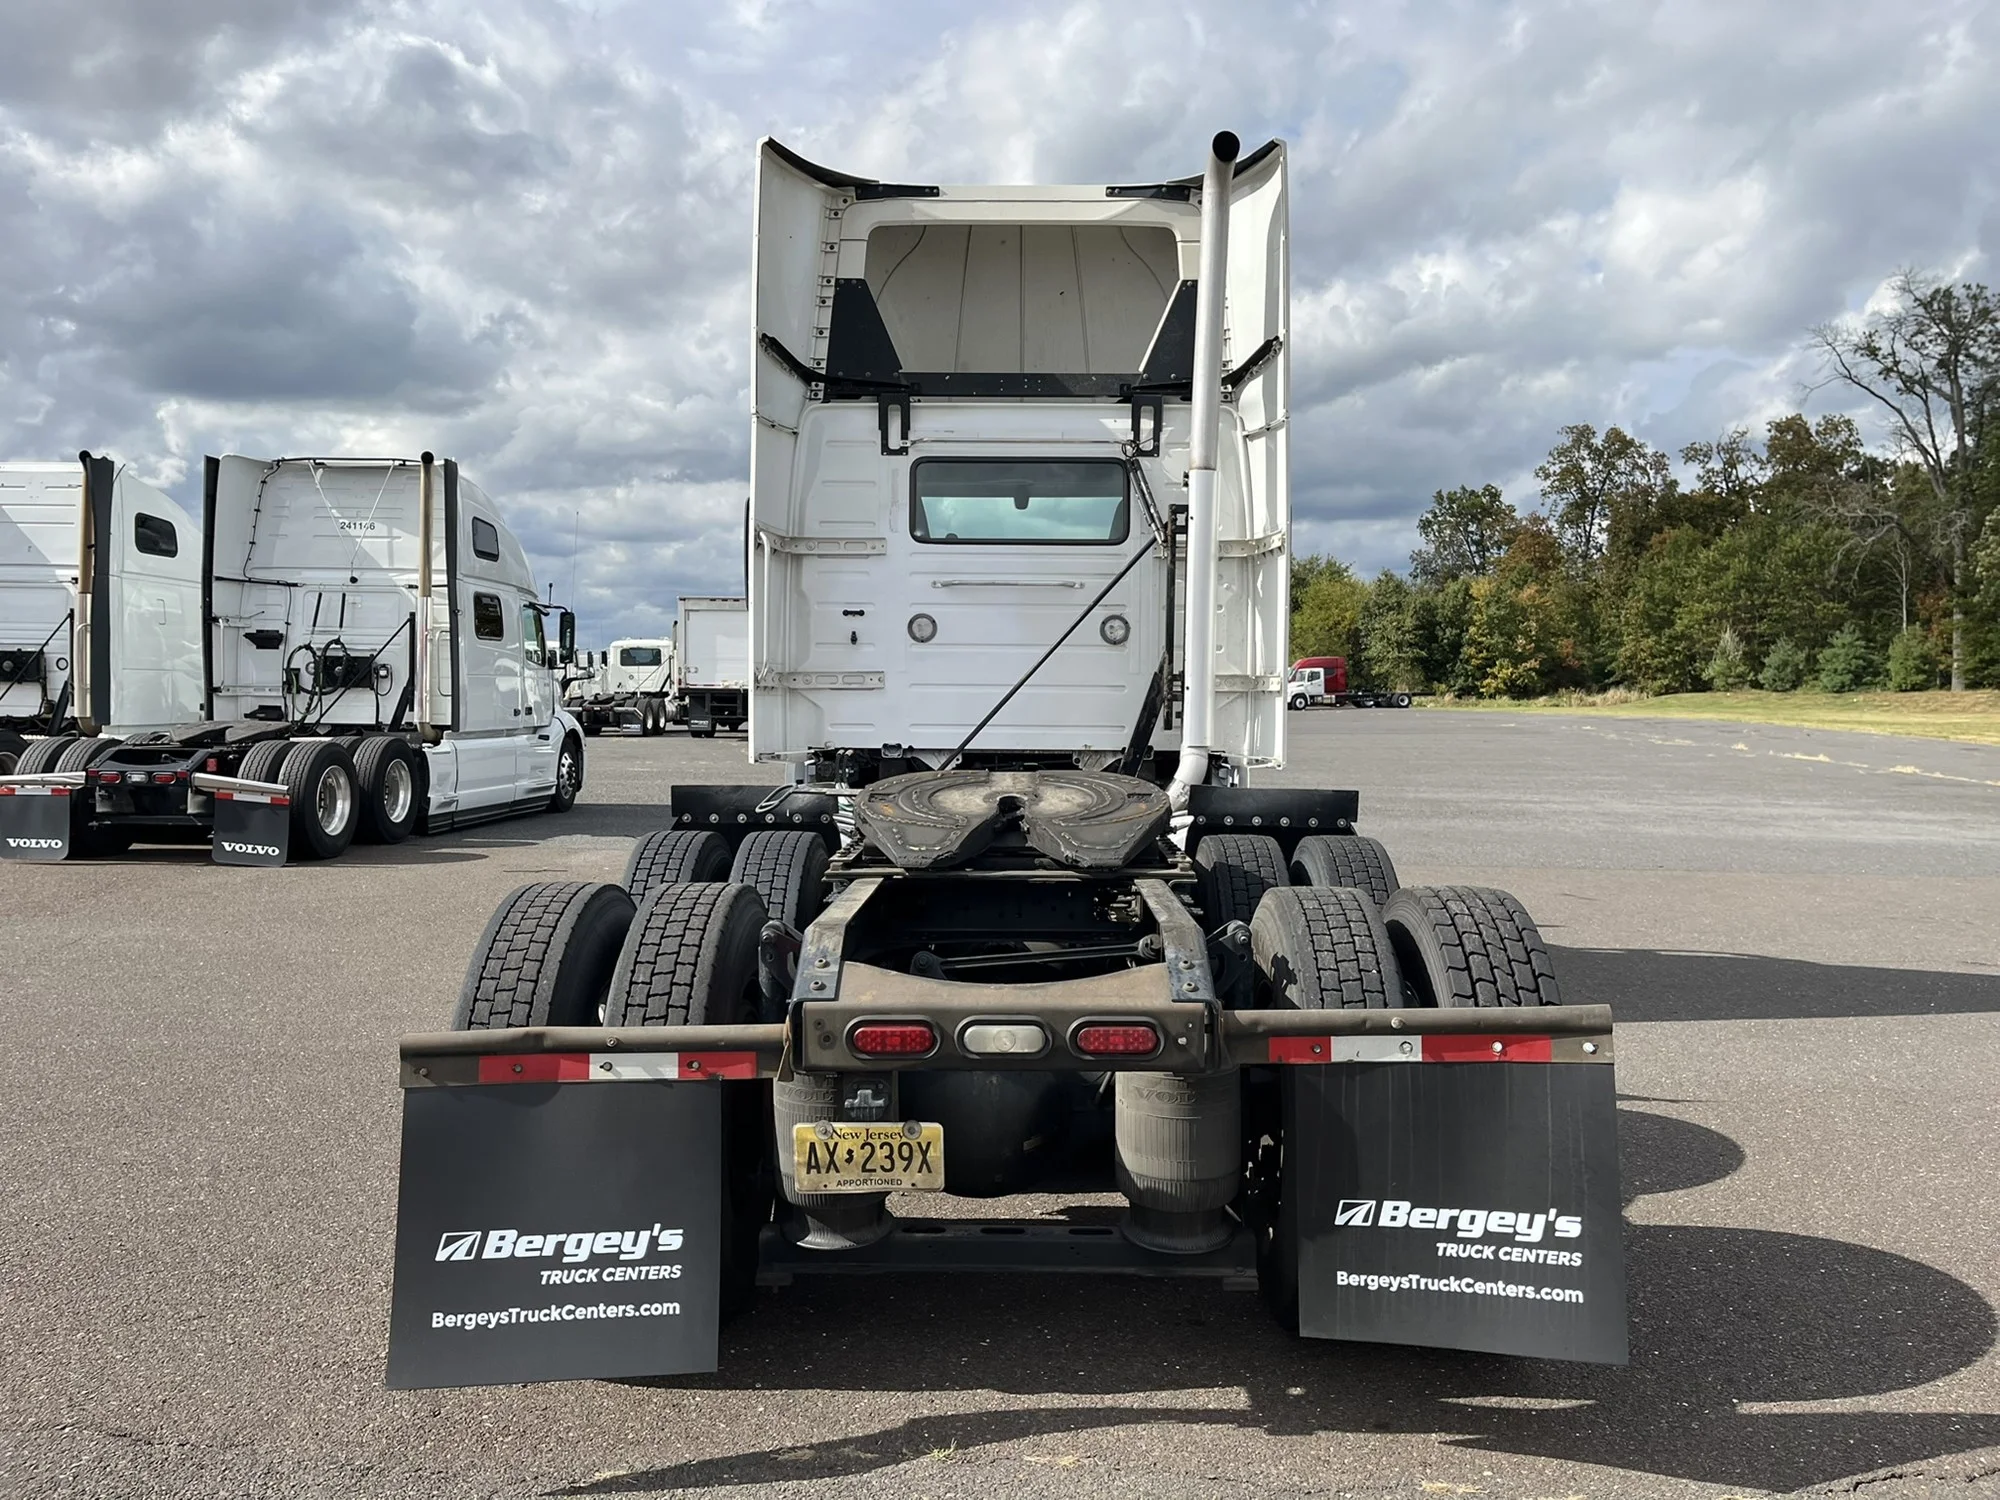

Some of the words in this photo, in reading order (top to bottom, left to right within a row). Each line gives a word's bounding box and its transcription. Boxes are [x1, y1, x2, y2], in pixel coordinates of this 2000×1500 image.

[6, 837, 63, 850] VOLVO
[221, 841, 280, 857] VOLVO
[831, 1128, 862, 1141] New
[863, 1128, 905, 1142] Jersey
[806, 1141, 841, 1175] AX
[860, 1141, 933, 1174] 239X
[836, 1177, 903, 1187] APPORTIONED
[1377, 1199, 1583, 1243] Bergey's
[481, 1222, 684, 1264] Bergey's
[1435, 1242, 1497, 1261] TRUCK
[1498, 1246, 1583, 1267] CENTERS
[540, 1267, 600, 1286] TRUCK
[602, 1264, 683, 1283] CENTERS
[1336, 1270, 1584, 1304] BergeysTruckCenters.com
[431, 1301, 681, 1331] BergeysTruckCenters.com
